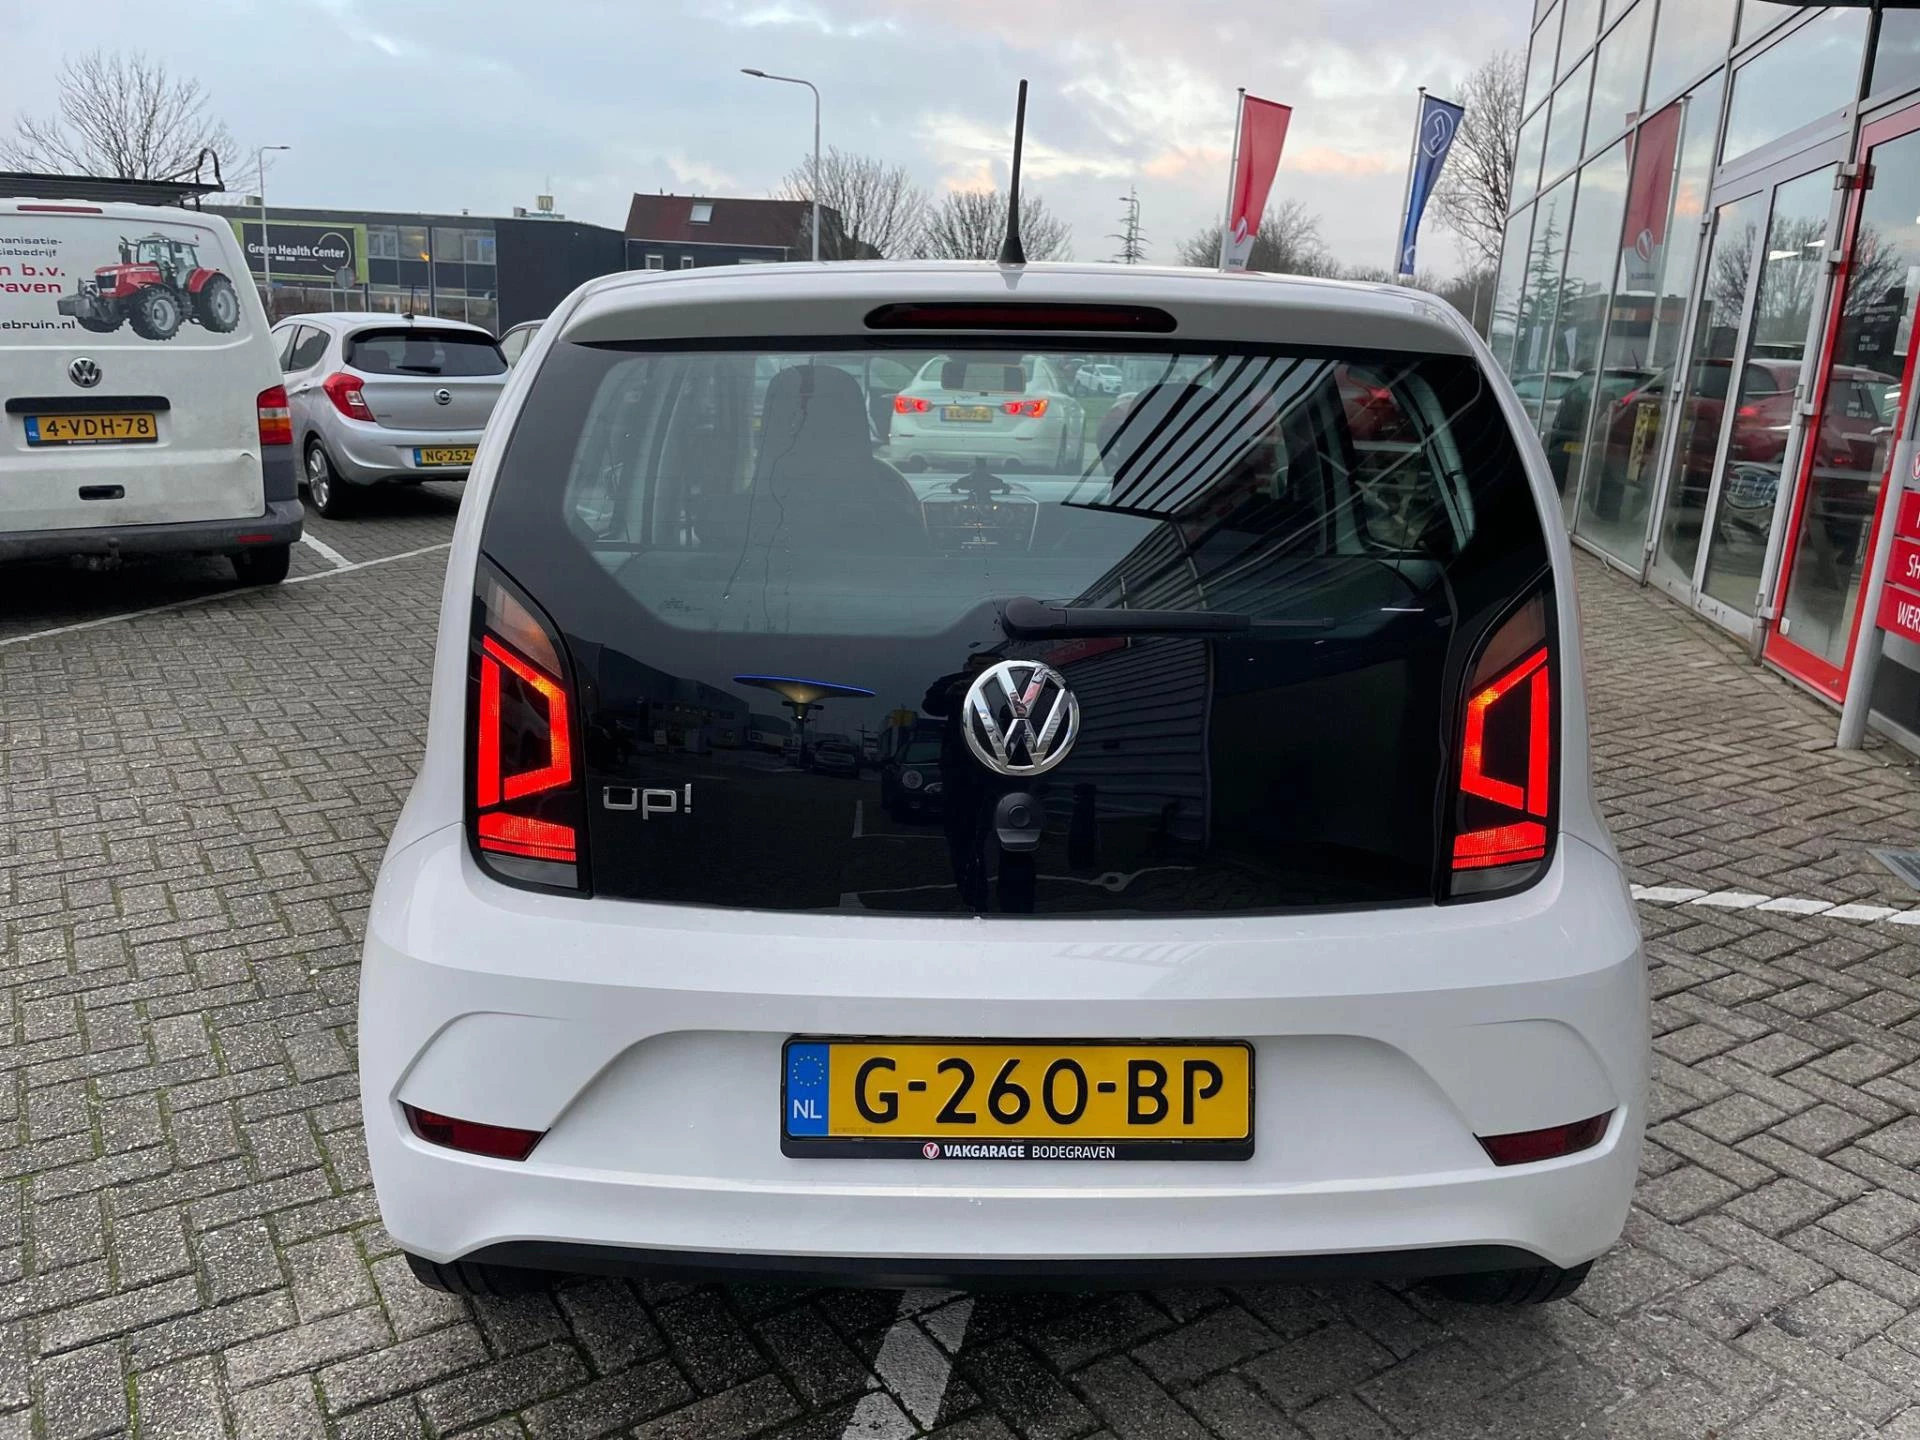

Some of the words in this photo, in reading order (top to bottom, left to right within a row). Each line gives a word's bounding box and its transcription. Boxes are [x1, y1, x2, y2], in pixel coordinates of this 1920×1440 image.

[278, 245, 311, 256] Health
[312, 246, 345, 258] Center
[21, 263, 66, 277] b.v.
[46, 417, 150, 437] 4-VDH-78
[602, 783, 692, 820] up!
[854, 1057, 1224, 1125] G-260-BP
[793, 1099, 822, 1119] NL
[944, 1144, 1025, 1158] VAKGARAGE
[1032, 1145, 1115, 1159] BODEGRAVEN
